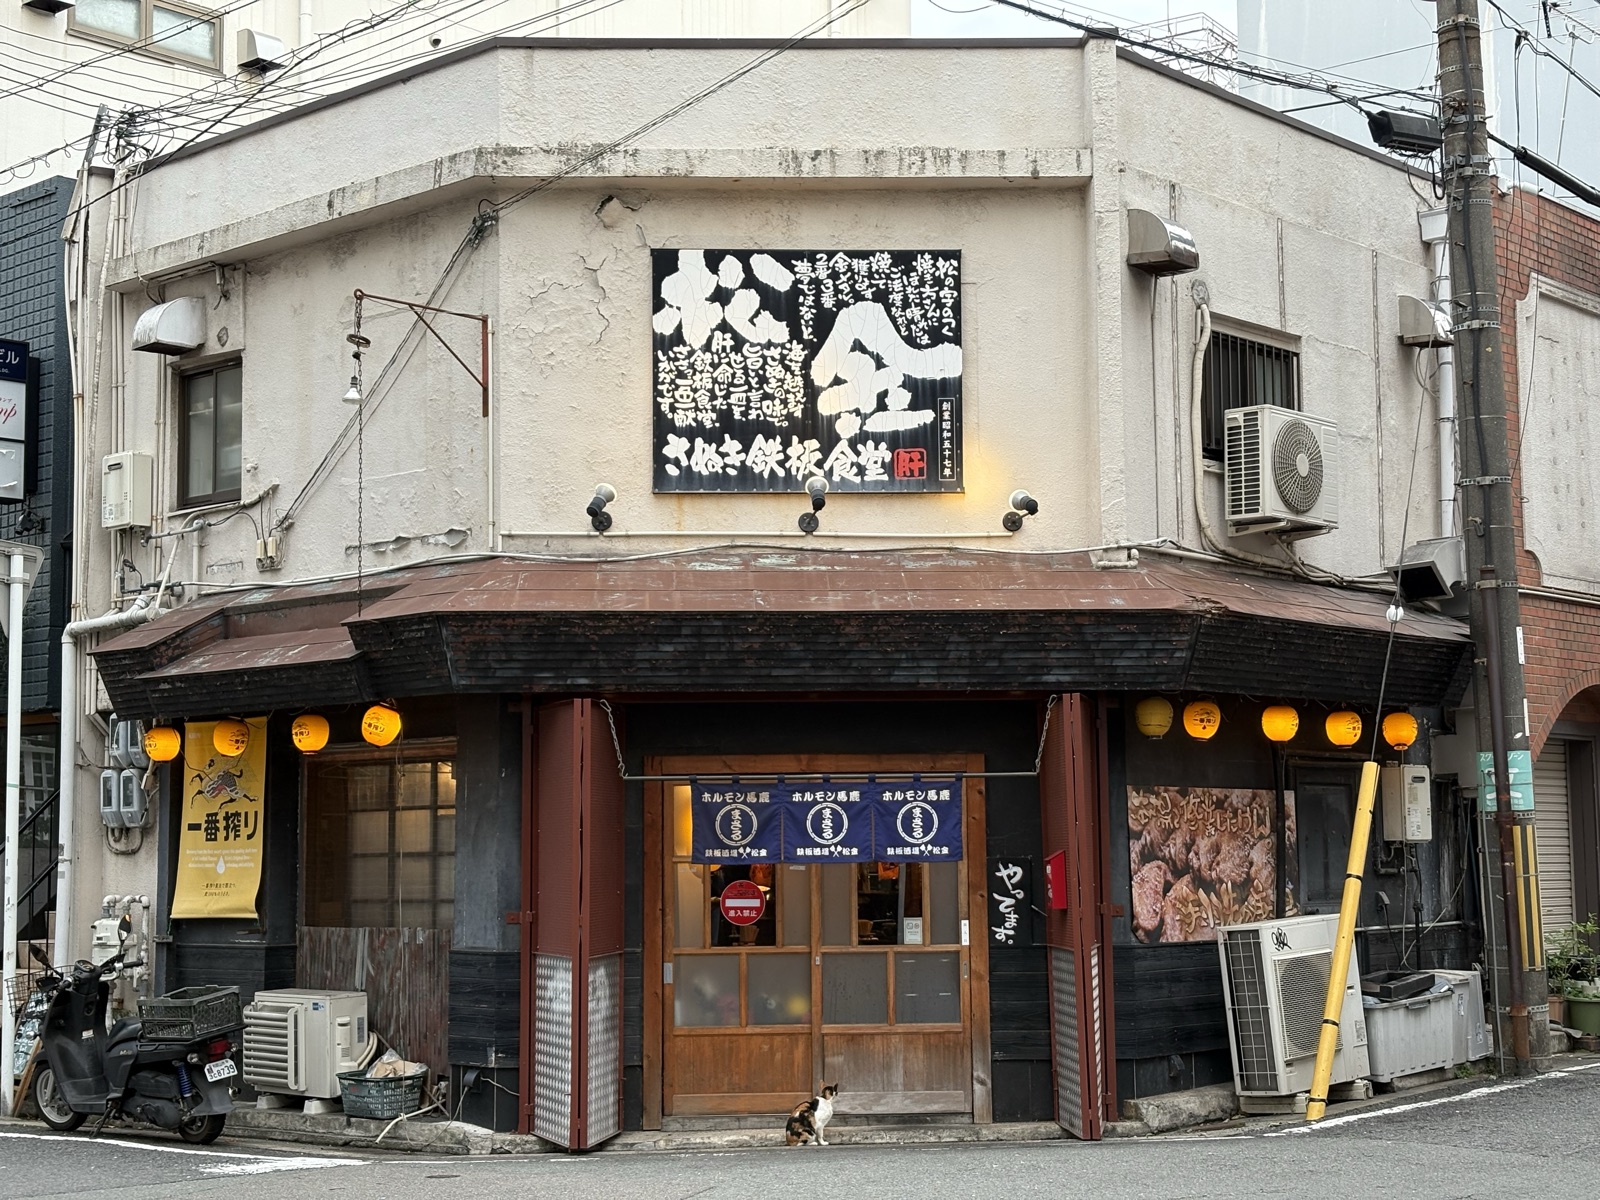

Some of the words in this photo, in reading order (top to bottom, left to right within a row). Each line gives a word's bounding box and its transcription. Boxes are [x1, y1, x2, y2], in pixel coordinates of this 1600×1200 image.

[712, 330, 734, 409] 肝に命じた
[942, 401, 952, 478] 創業昭和五十七年
[662, 432, 892, 483] さぬき鉄板食堂
[702, 792, 770, 803] ホルモン馬鹿
[792, 790, 860, 802] ホルモン馬鹿
[882, 789, 950, 801] ホルモン馬鹿
[187, 810, 259, 842] 一番搾り
[728, 909, 758, 917] 進入禁止
